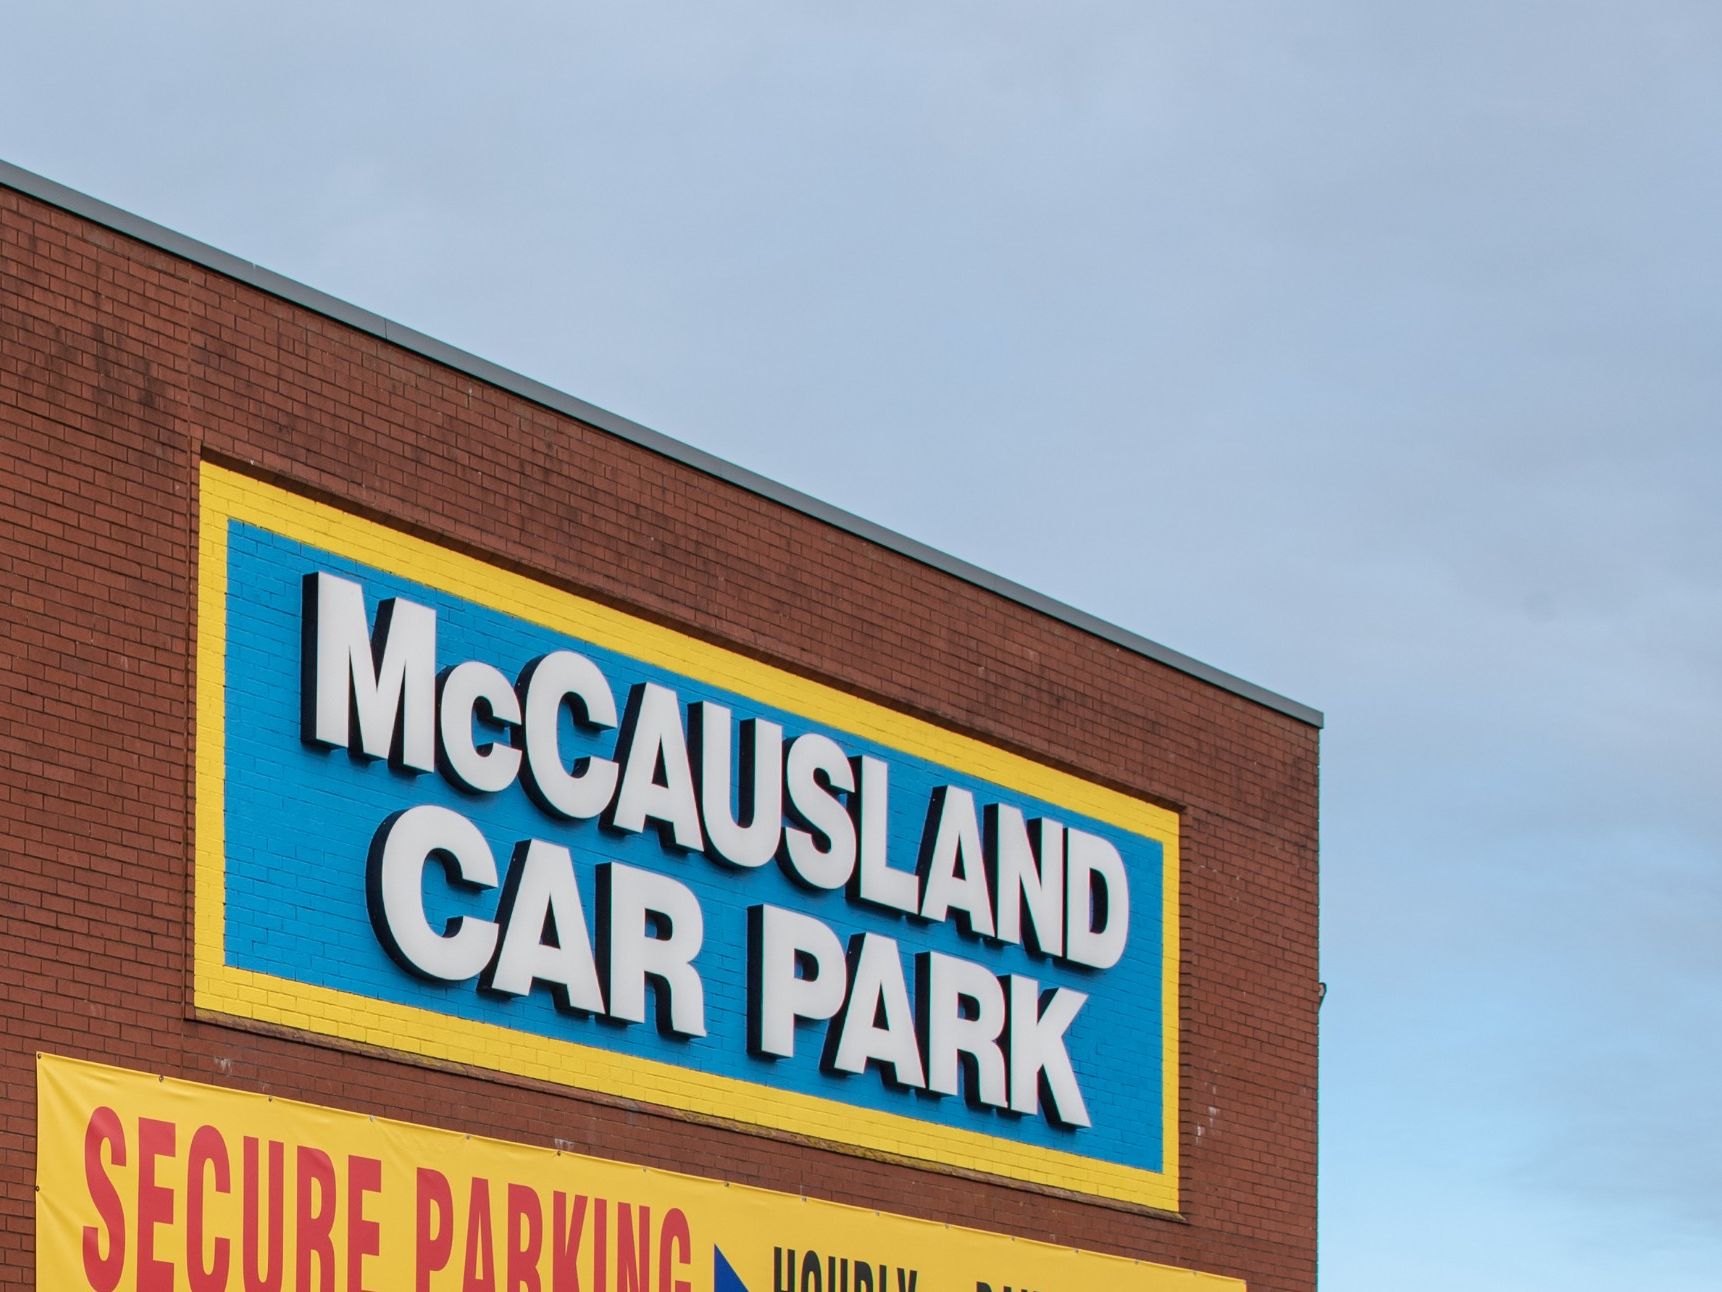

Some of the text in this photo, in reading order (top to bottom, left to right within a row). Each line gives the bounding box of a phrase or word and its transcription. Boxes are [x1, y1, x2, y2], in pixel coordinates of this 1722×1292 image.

[301, 570, 1130, 971] McCAUSLAND
[366, 805, 1091, 1128] CAR PARK
